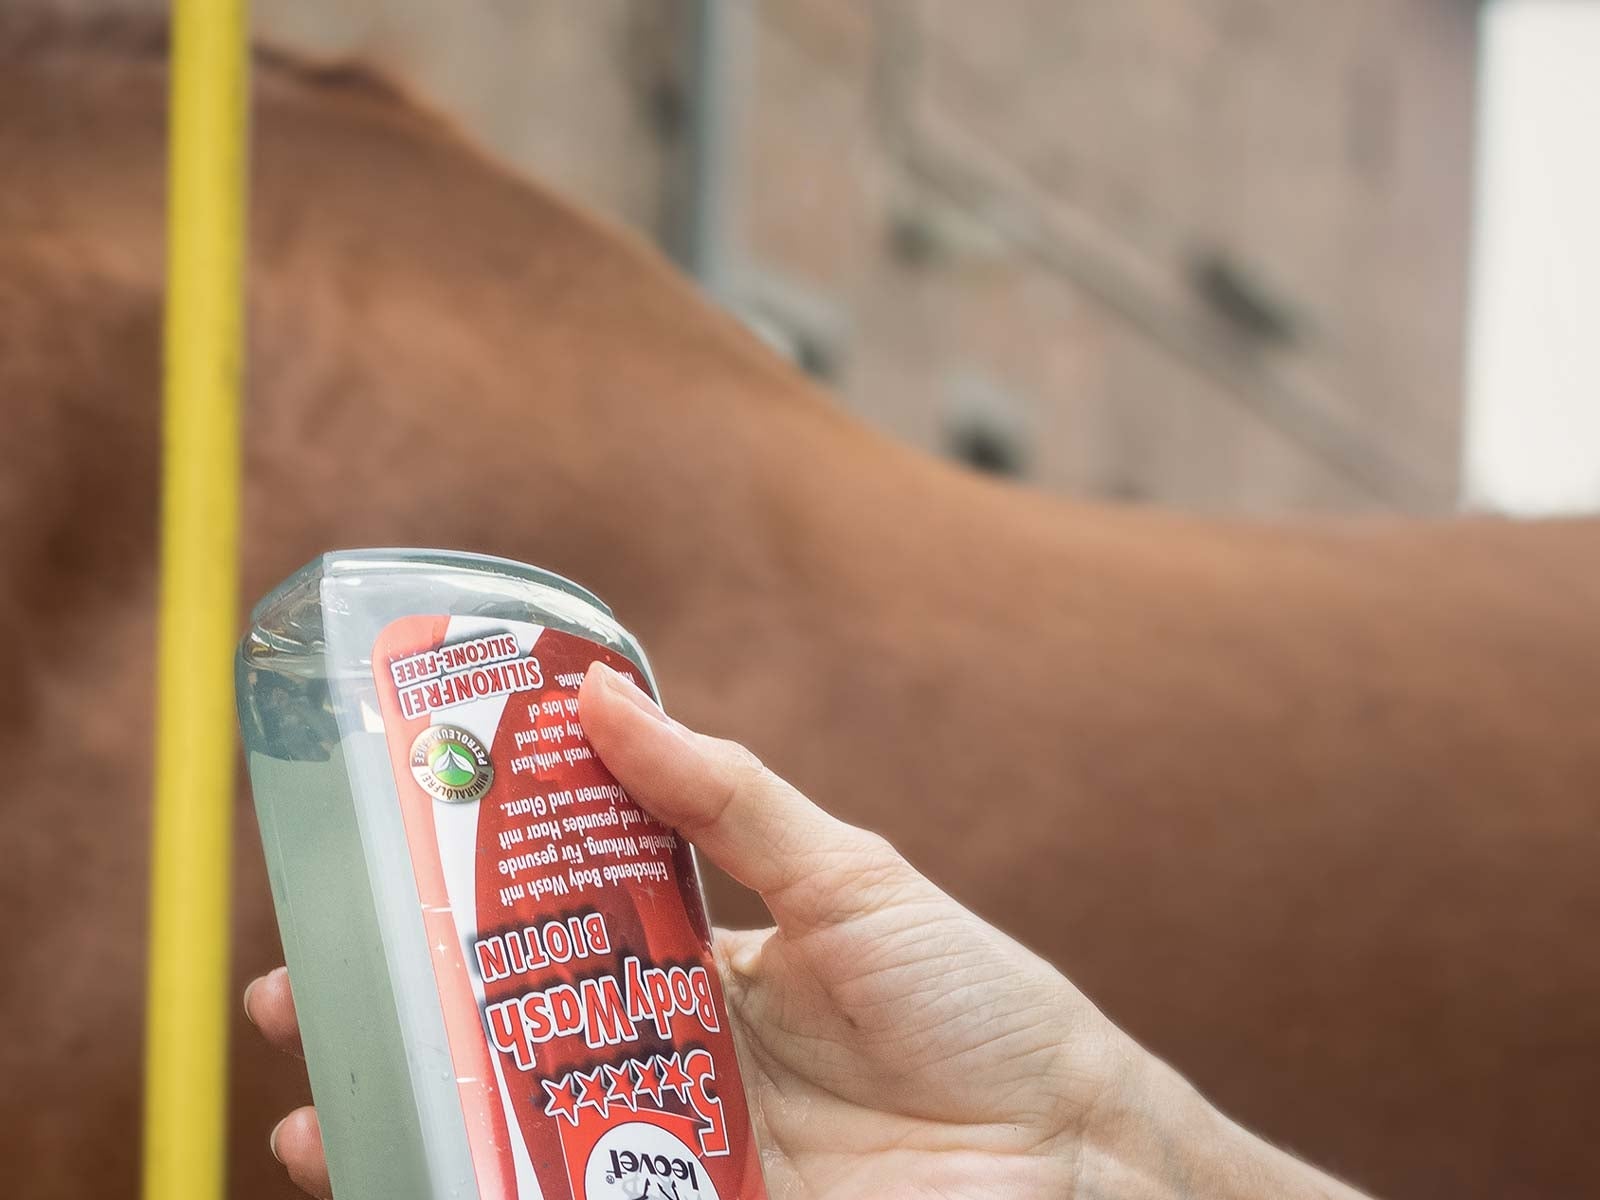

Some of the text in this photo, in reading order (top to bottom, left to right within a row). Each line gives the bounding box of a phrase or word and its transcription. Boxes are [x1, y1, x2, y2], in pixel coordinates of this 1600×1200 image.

[394, 636, 518, 685] SILICONE-FREE
[400, 659, 541, 718] SILIKONFREI
[527, 703, 540, 723] of
[542, 699, 565, 717] lots
[514, 729, 538, 751] and
[541, 724, 565, 744] skin
[510, 746, 592, 775] wash with fast
[499, 785, 628, 818] Volumen und Glanz.
[527, 820, 562, 840] Haar
[562, 806, 619, 837] gesundes
[620, 809, 641, 831] und
[498, 829, 524, 850] mit
[498, 834, 677, 879] schneller Wirkung. Für gesunde
[499, 861, 668, 906] Erfrischende Body Wash mit
[475, 913, 611, 983] BIOTIN
[486, 957, 719, 1071] BodyWash
[683, 1050, 729, 1156] 5
